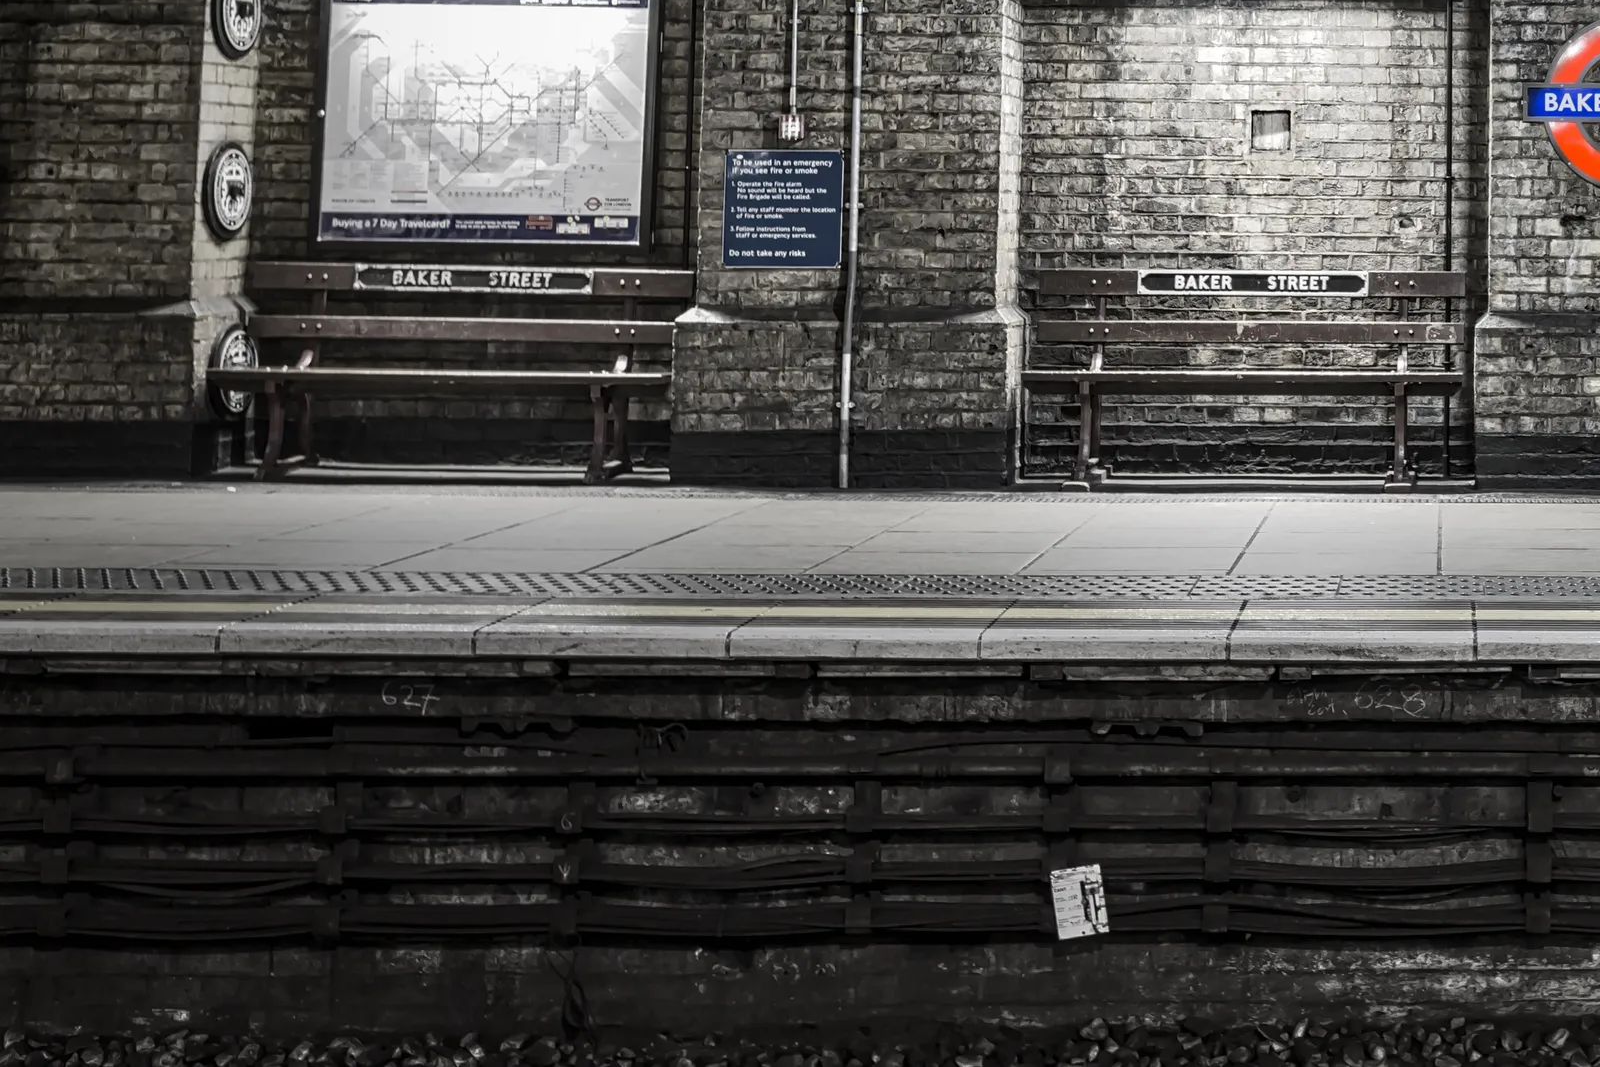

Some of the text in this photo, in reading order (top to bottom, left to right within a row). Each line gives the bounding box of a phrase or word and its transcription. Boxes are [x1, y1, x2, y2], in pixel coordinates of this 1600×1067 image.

[770, 166, 783, 174] fire
[793, 160, 833, 168] emergency
[332, 217, 363, 230] Buying
[364, 219, 371, 228] a
[372, 218, 378, 228] 7
[380, 218, 398, 230] Day
[400, 218, 450, 229] Travelcard?
[728, 249, 740, 257] Do
[756, 249, 773, 257] take
[774, 250, 787, 258] any
[788, 249, 806, 257] risks
[392, 270, 553, 289] BAKER STREET
[1173, 274, 1330, 292] BAKER STREET
[381, 682, 441, 716] 627
[1354, 681, 1429, 718] 628
